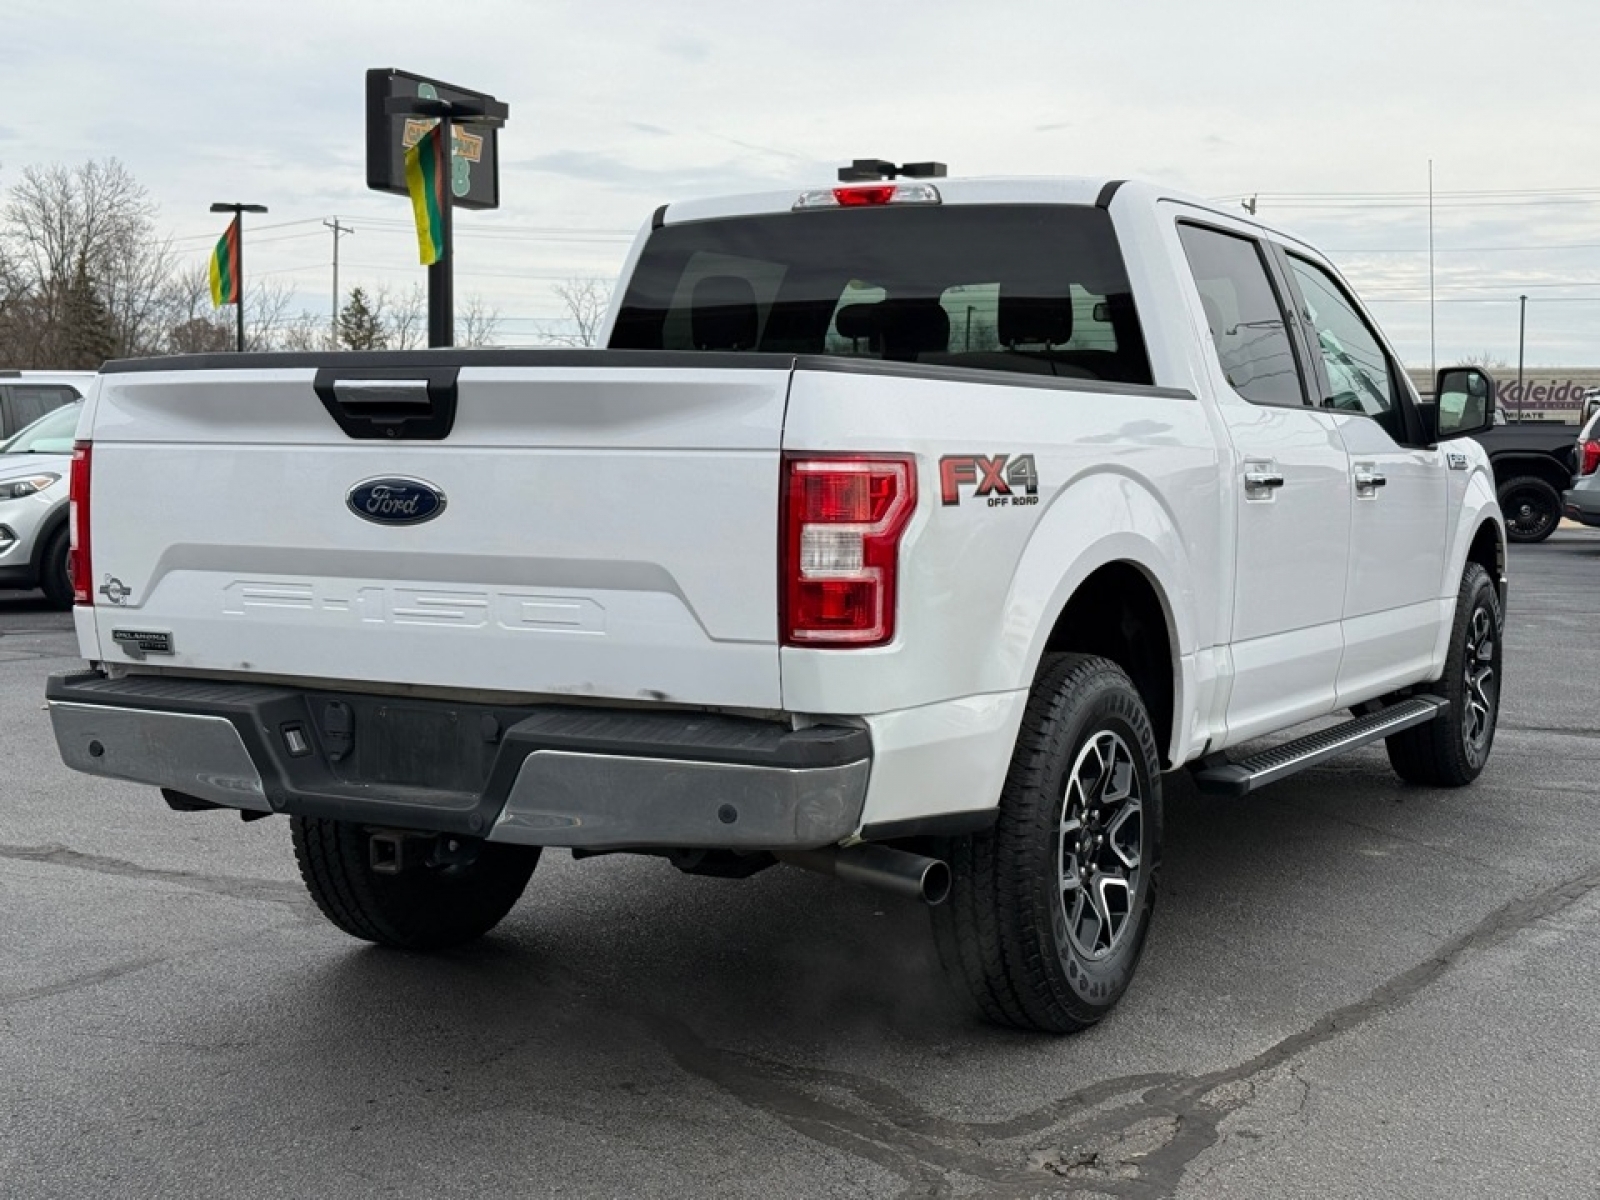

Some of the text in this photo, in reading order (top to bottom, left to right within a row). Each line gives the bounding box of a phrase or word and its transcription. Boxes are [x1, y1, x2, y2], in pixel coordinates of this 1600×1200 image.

[1496, 380, 1598, 401] Kaleido
[939, 453, 1038, 505] FX4
[366, 485, 419, 514] Ford
[987, 497, 1039, 507] OFF ROAD
[222, 579, 606, 636] F-150
